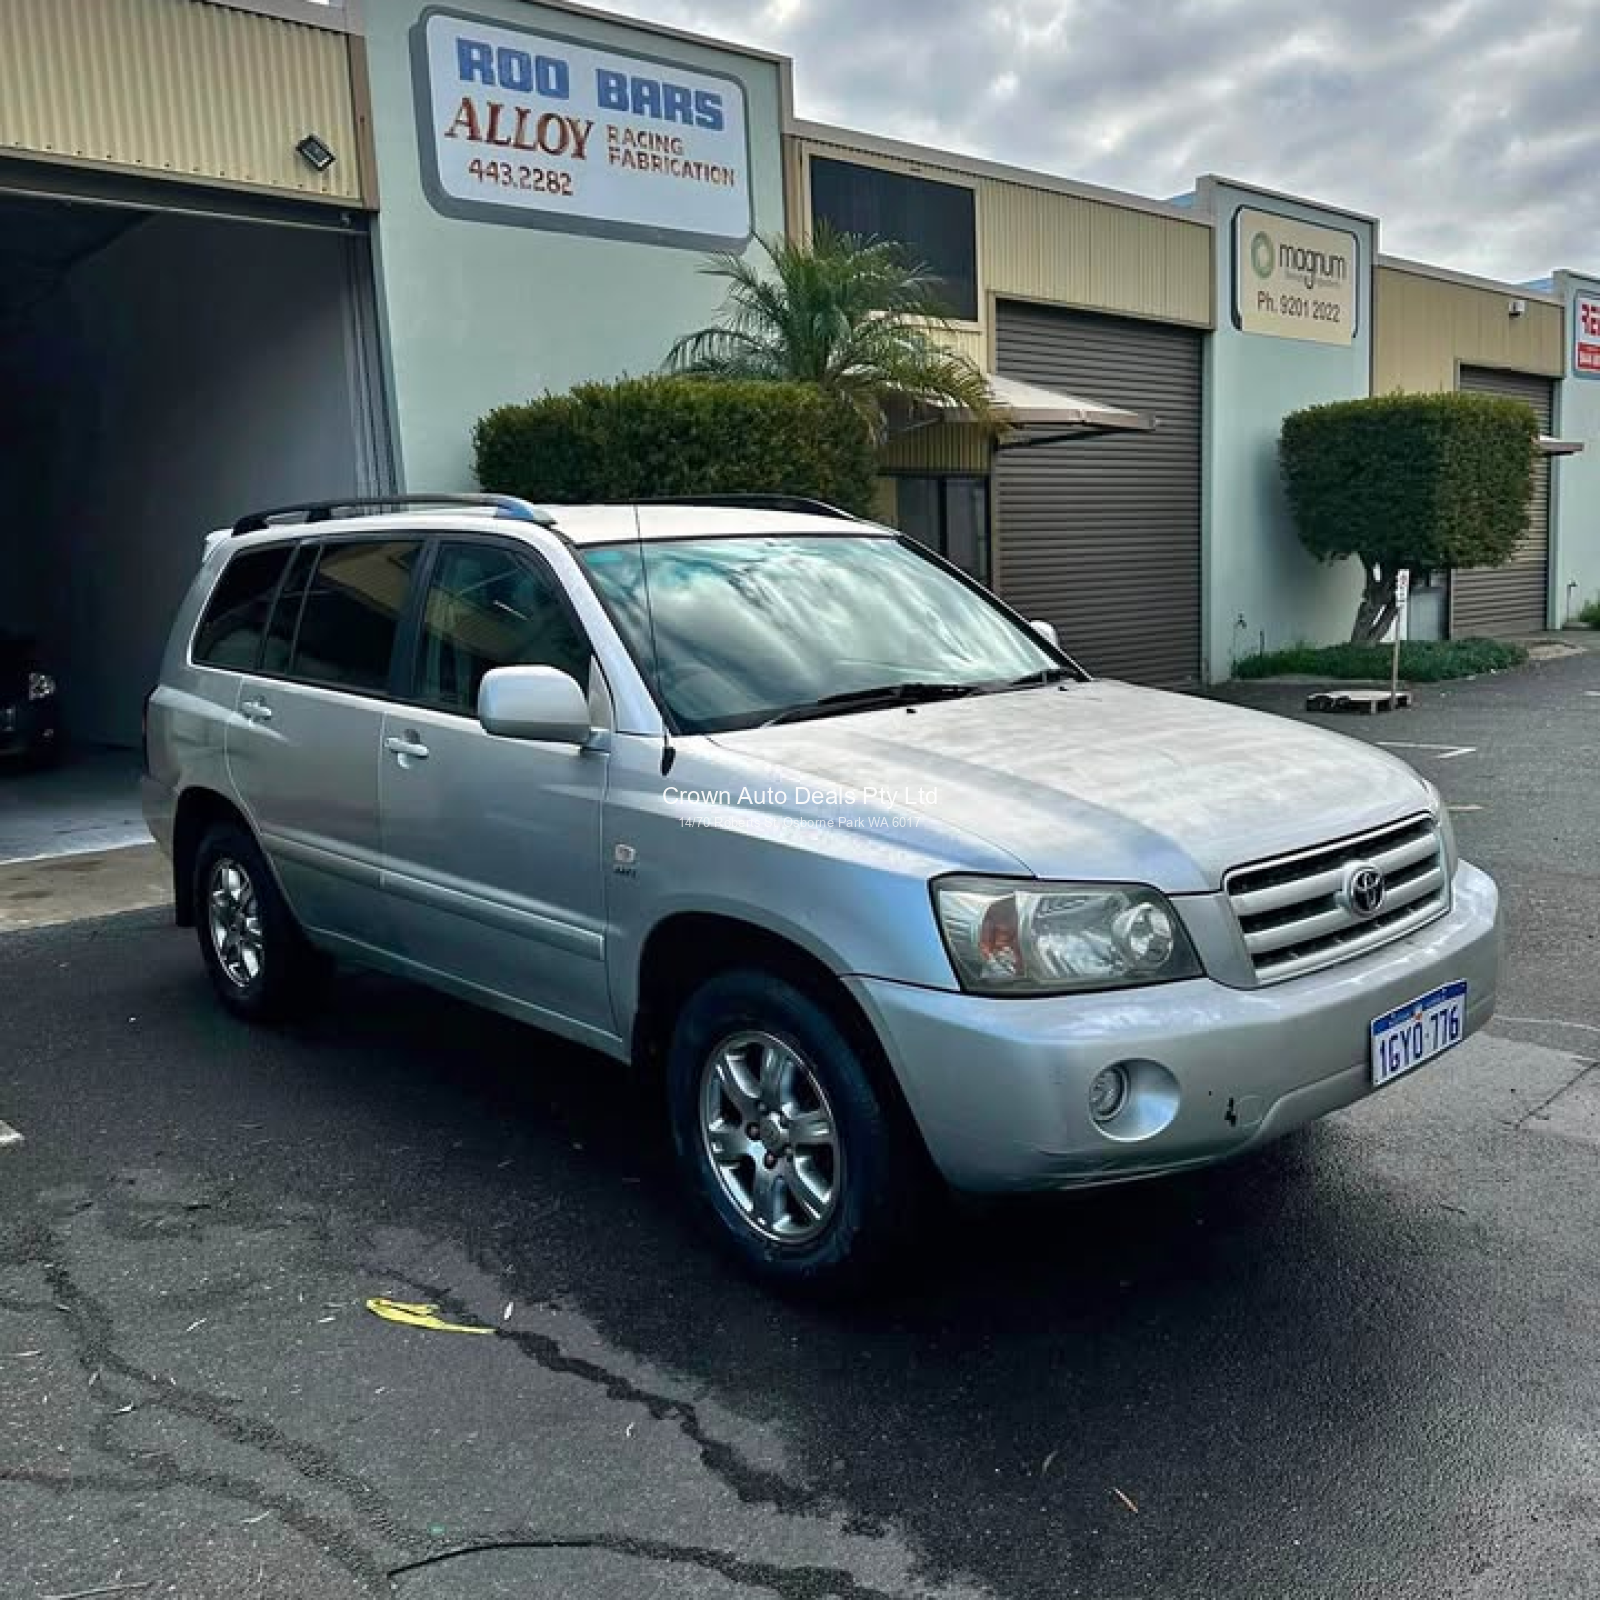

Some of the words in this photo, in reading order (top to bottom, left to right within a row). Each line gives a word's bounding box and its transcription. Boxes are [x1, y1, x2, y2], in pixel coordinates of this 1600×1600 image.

[455, 37, 570, 100] ROO
[595, 68, 724, 131] BARS
[444, 96, 595, 160] ALLOY
[607, 123, 684, 156] RACING
[608, 146, 736, 187] FABRICATION
[1279, 243, 1347, 290] magnum
[1257, 290, 1278, 312] Ph.
